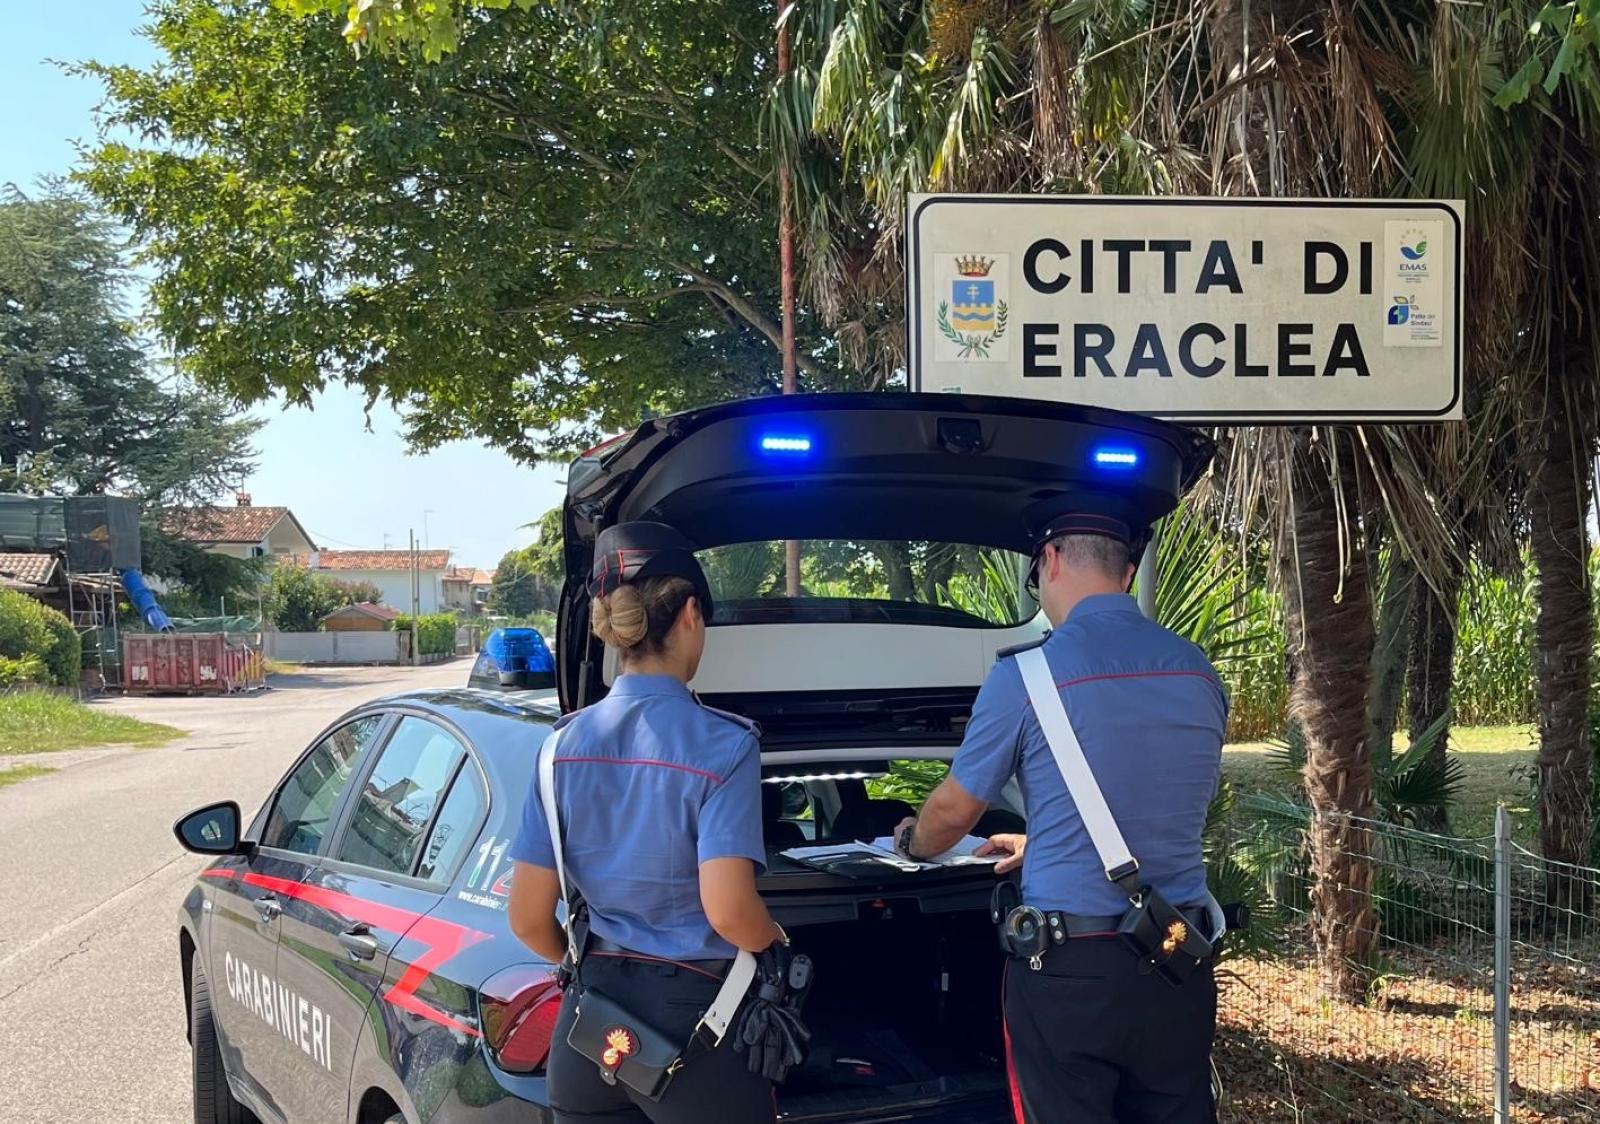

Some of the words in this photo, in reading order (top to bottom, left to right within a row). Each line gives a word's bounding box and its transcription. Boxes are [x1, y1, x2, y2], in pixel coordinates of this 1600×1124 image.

[1023, 238, 1263, 294] CITTA'
[1304, 241, 1372, 294] DI
[1399, 263, 1427, 271] EMAS
[1023, 323, 1370, 377] ERACLEA
[225, 951, 332, 1072] CARABINIERI
